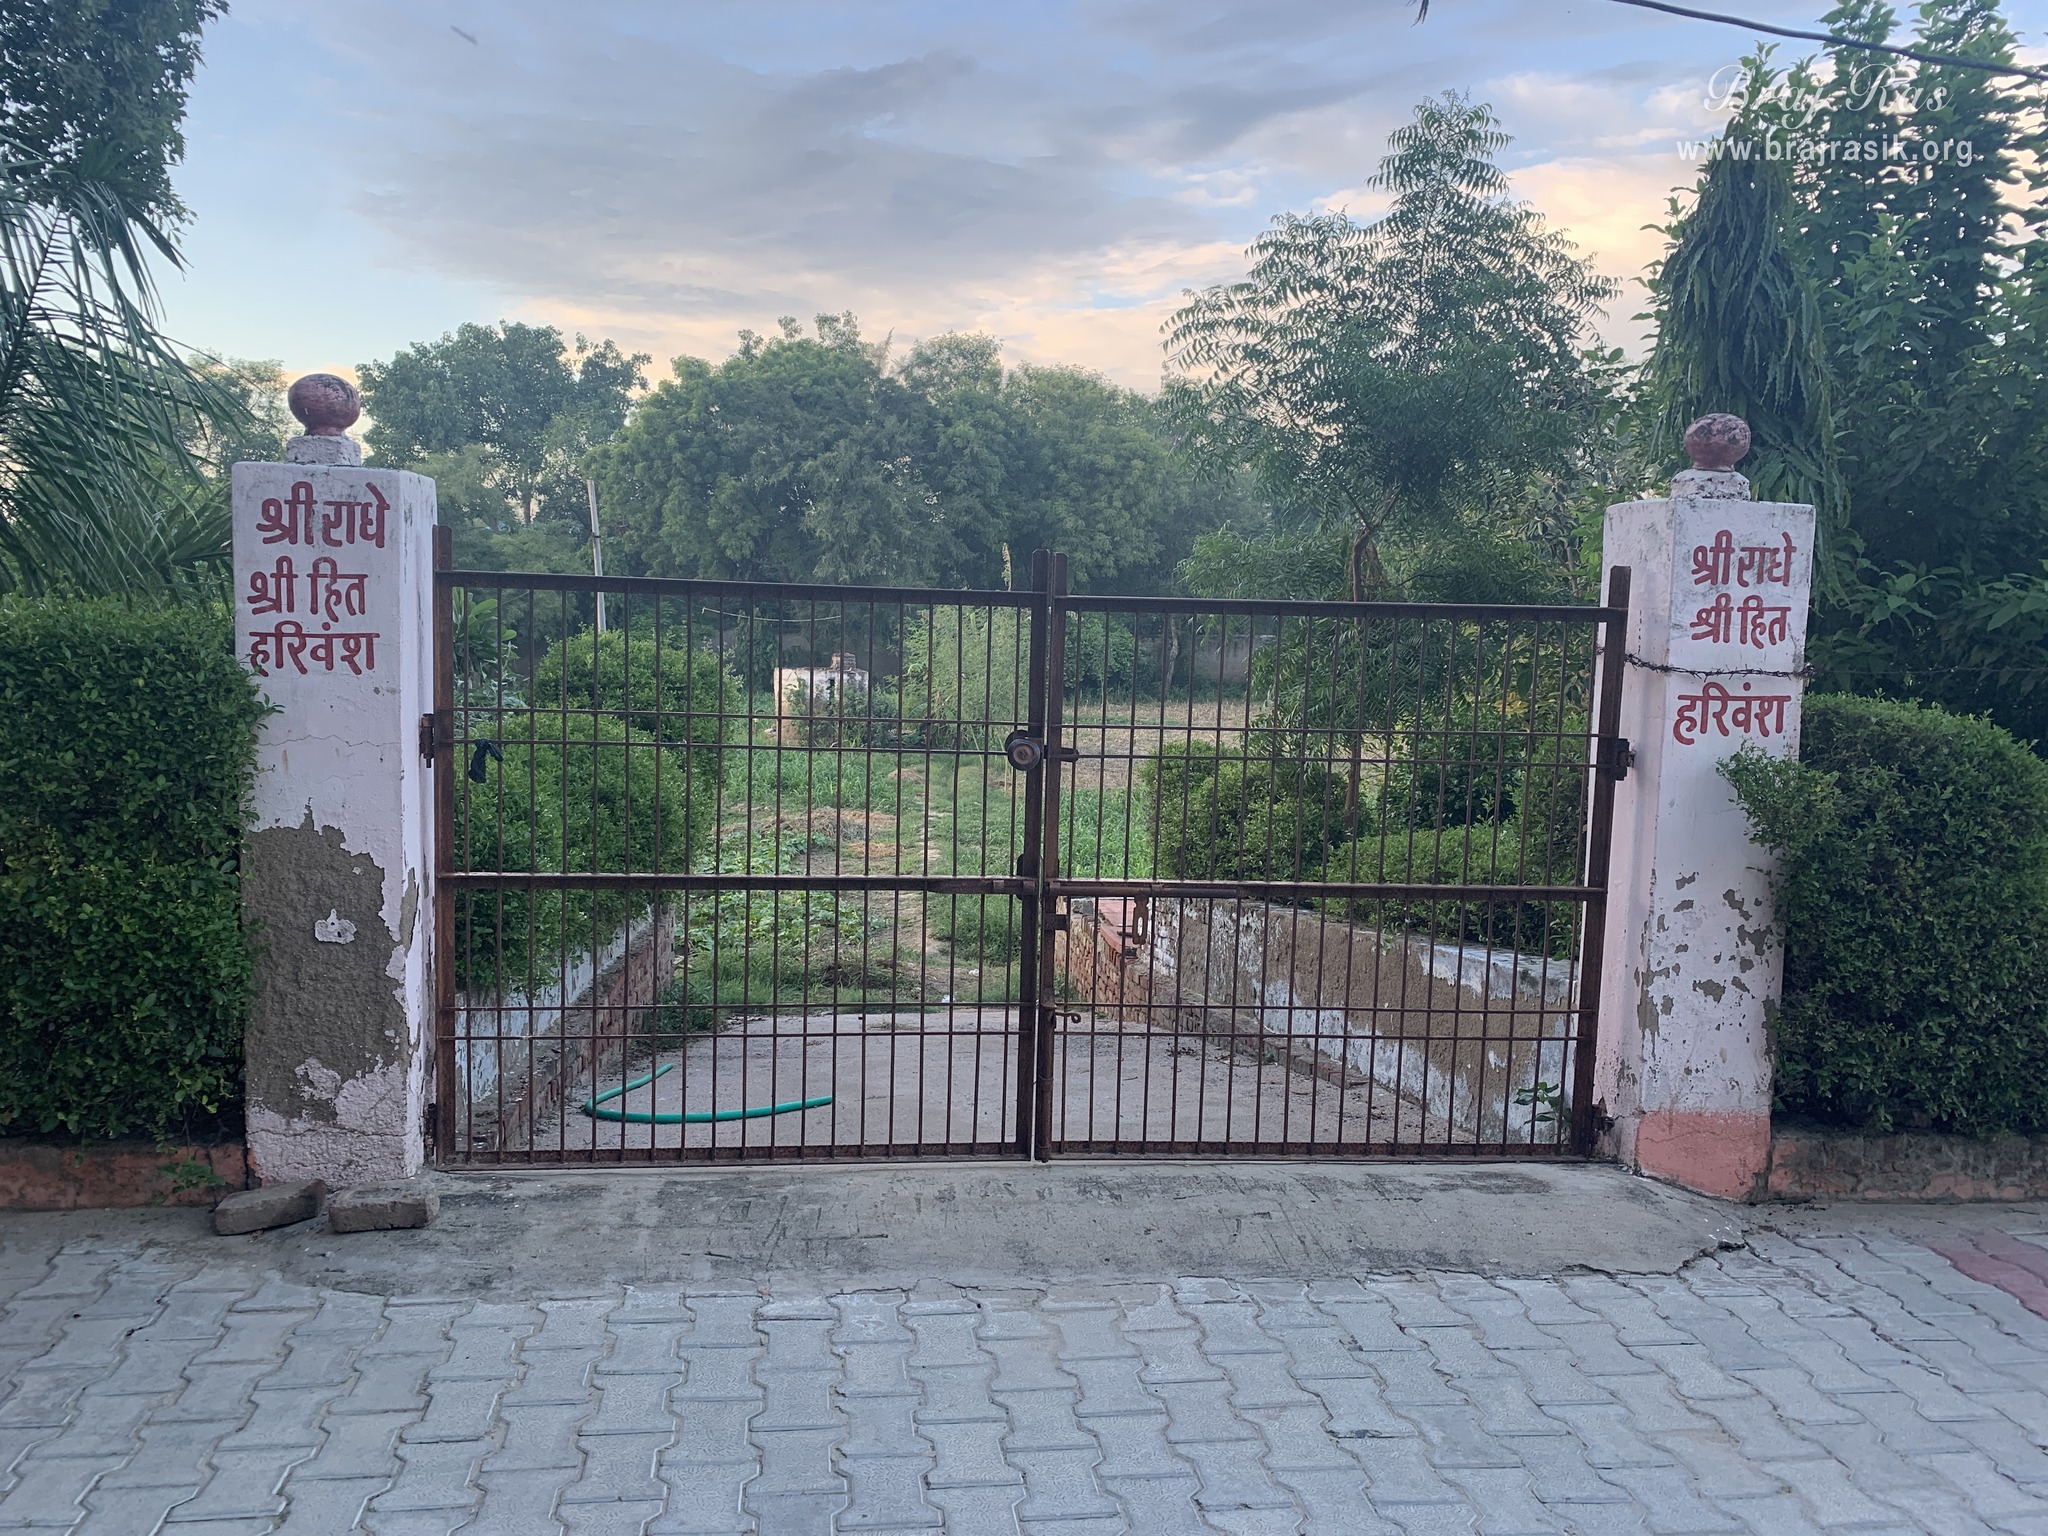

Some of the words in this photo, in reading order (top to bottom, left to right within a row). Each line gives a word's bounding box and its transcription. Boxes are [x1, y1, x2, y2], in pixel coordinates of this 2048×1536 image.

[256, 481, 318, 545] श्री
[321, 482, 391, 549] राधे
[1691, 529, 1735, 587] श्री
[1736, 531, 1798, 587] राधे
[246, 555, 299, 616] श्री
[306, 556, 369, 623] हित
[249, 620, 381, 677] हरिवंश
[1689, 592, 1734, 644] श्री
[1736, 594, 1792, 650] हित
[1672, 681, 1792, 746] हरिवंश
